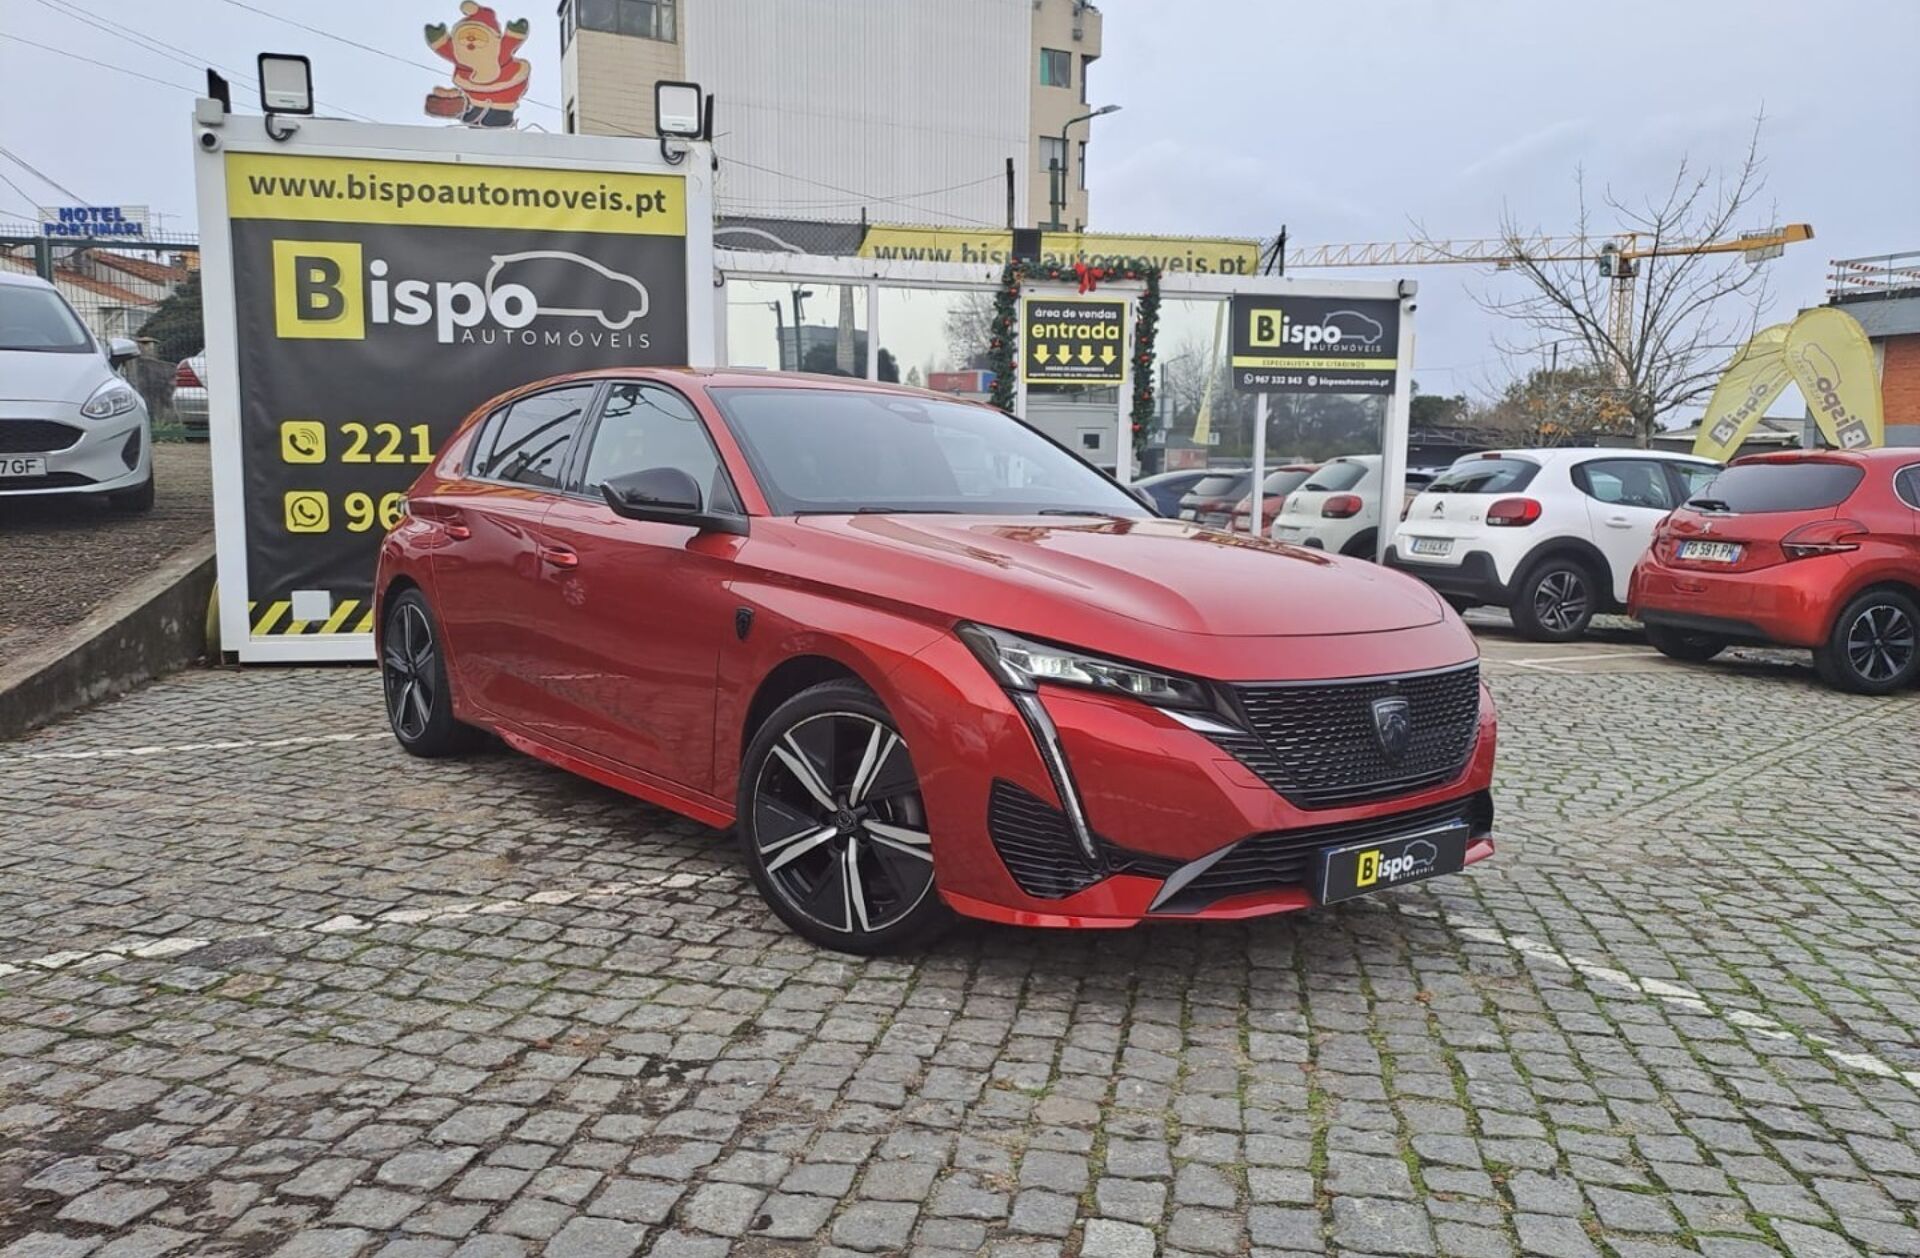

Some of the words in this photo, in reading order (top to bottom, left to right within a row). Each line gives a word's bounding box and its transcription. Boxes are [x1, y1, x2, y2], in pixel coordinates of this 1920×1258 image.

[248, 173, 667, 217] www.bispoautomoveis.pt
[59, 207, 125, 222] HOTEL
[293, 254, 539, 343] Bispo
[1034, 307, 1060, 318] área
[1062, 307, 1076, 319] de
[1078, 308, 1118, 320] vendas
[461, 327, 651, 349] AUTOMÓVEIS
[1031, 321, 1120, 339] entrada
[1256, 315, 1342, 351] Bispo
[1312, 343, 1383, 353] AUTOMÓVEIS
[1711, 383, 1769, 446] Bispo
[340, 422, 436, 463] 221
[1361, 853, 1414, 881] Bispo
